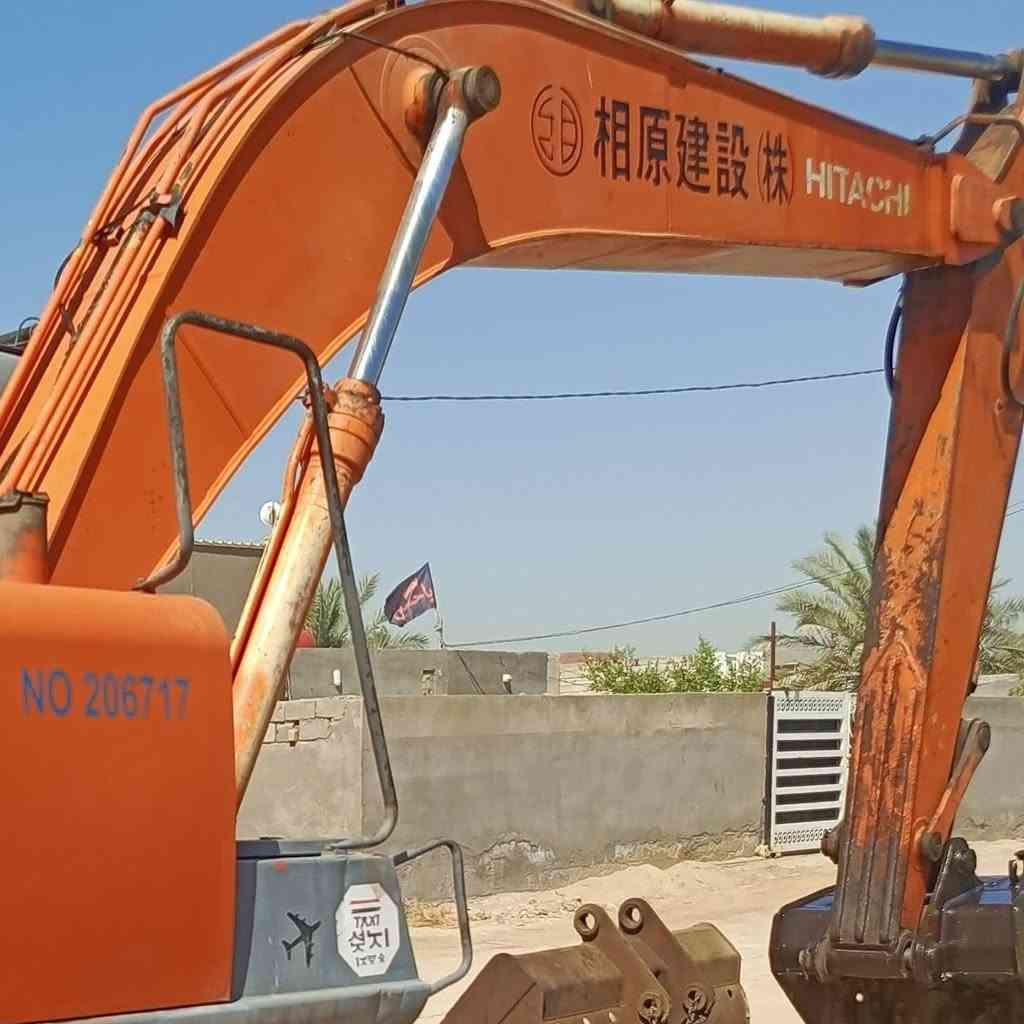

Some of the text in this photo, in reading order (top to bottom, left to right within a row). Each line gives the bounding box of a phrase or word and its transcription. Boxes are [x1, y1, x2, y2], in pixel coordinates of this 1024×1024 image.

[806, 158, 911, 216] HITACHI
[20, 667, 191, 720] NO 206717
